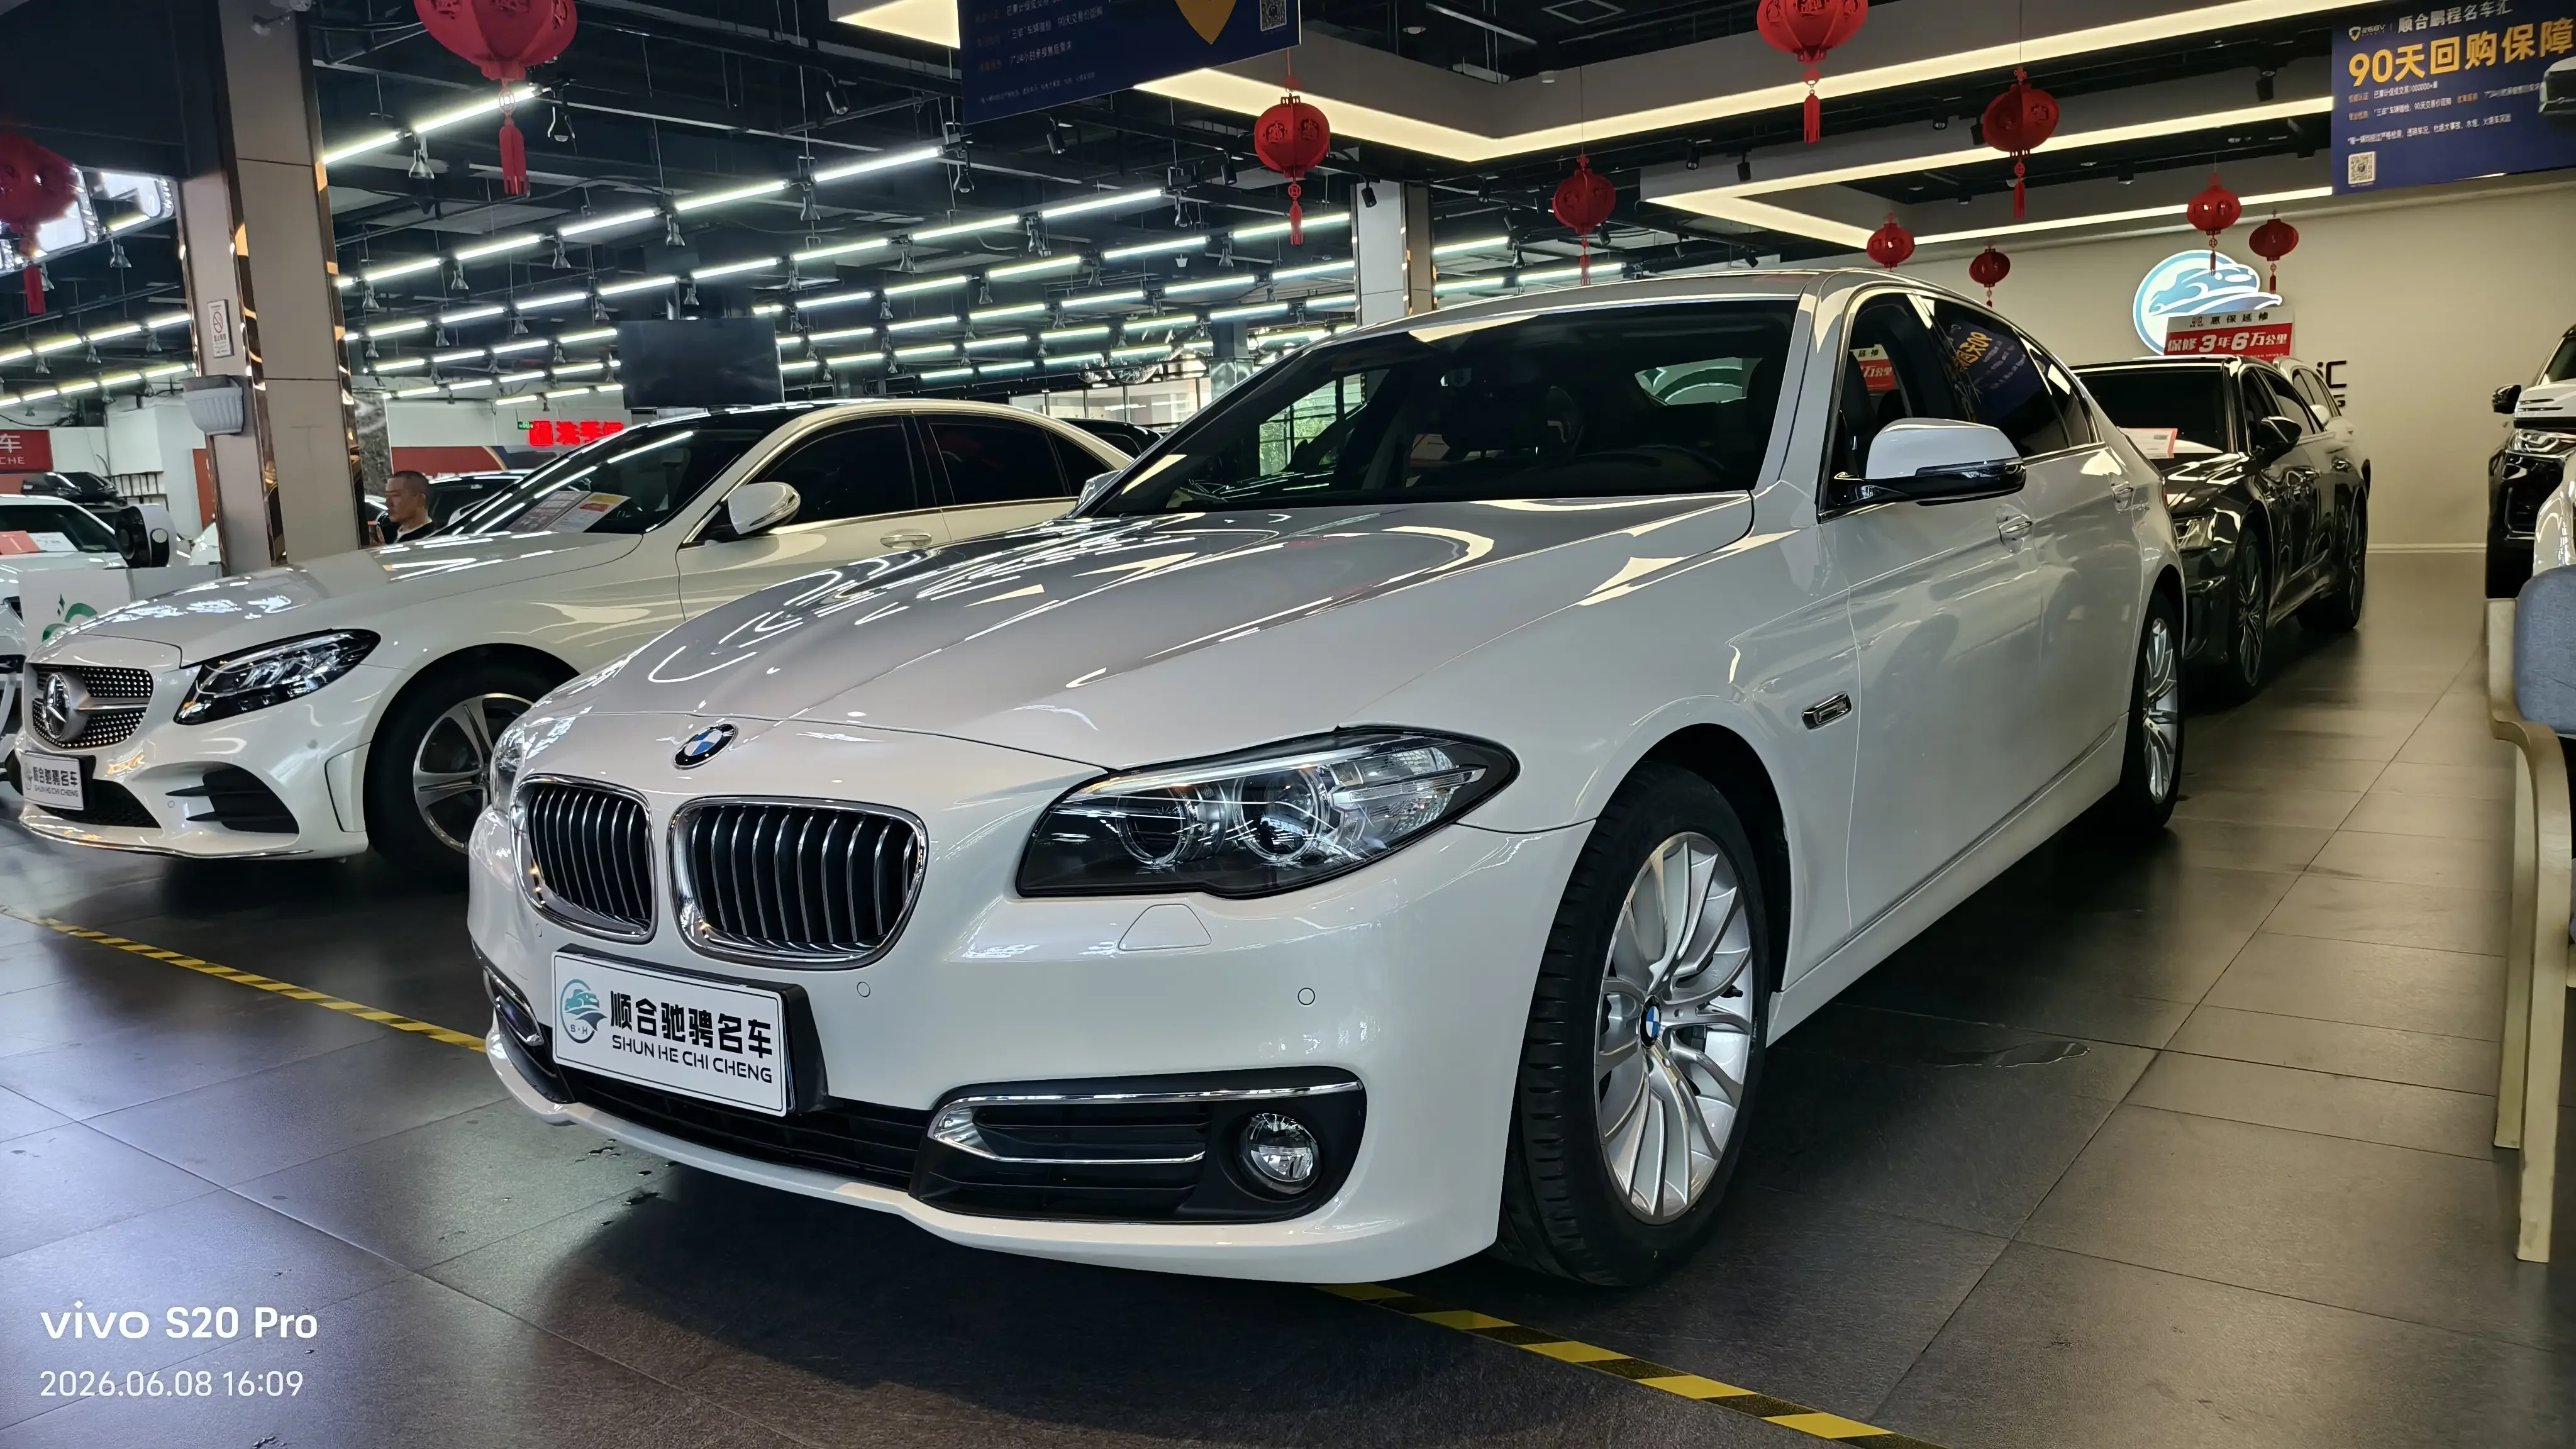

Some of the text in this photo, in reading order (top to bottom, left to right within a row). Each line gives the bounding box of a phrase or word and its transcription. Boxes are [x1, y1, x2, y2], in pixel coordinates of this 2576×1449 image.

[2348, 18, 2574, 87] 90天回购保障
[610, 991, 772, 1058] 顺合驰骋名车
[612, 1035, 772, 1084] SHUN HE CHI CHENG
